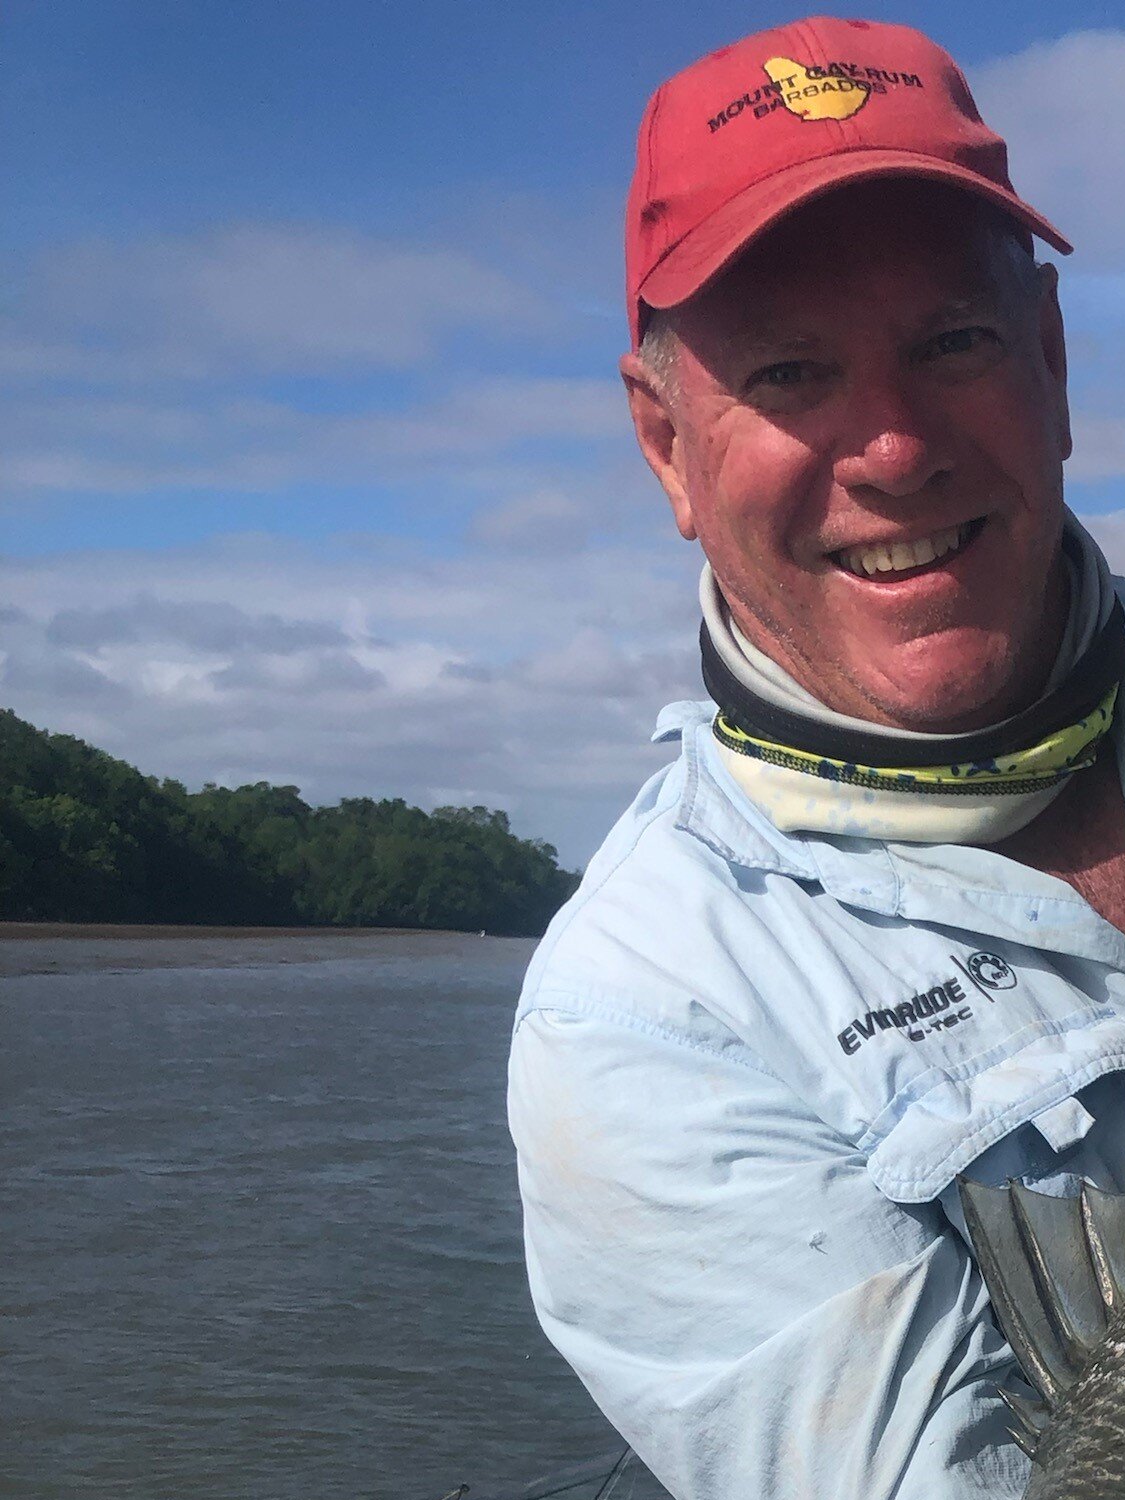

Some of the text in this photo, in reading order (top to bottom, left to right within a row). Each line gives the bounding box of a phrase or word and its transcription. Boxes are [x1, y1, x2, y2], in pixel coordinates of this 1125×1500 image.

[707, 61, 923, 133] MOUNT GAY RUM
[753, 78, 888, 120] BARBADOS
[837, 977, 966, 1056] EVINRUDE
